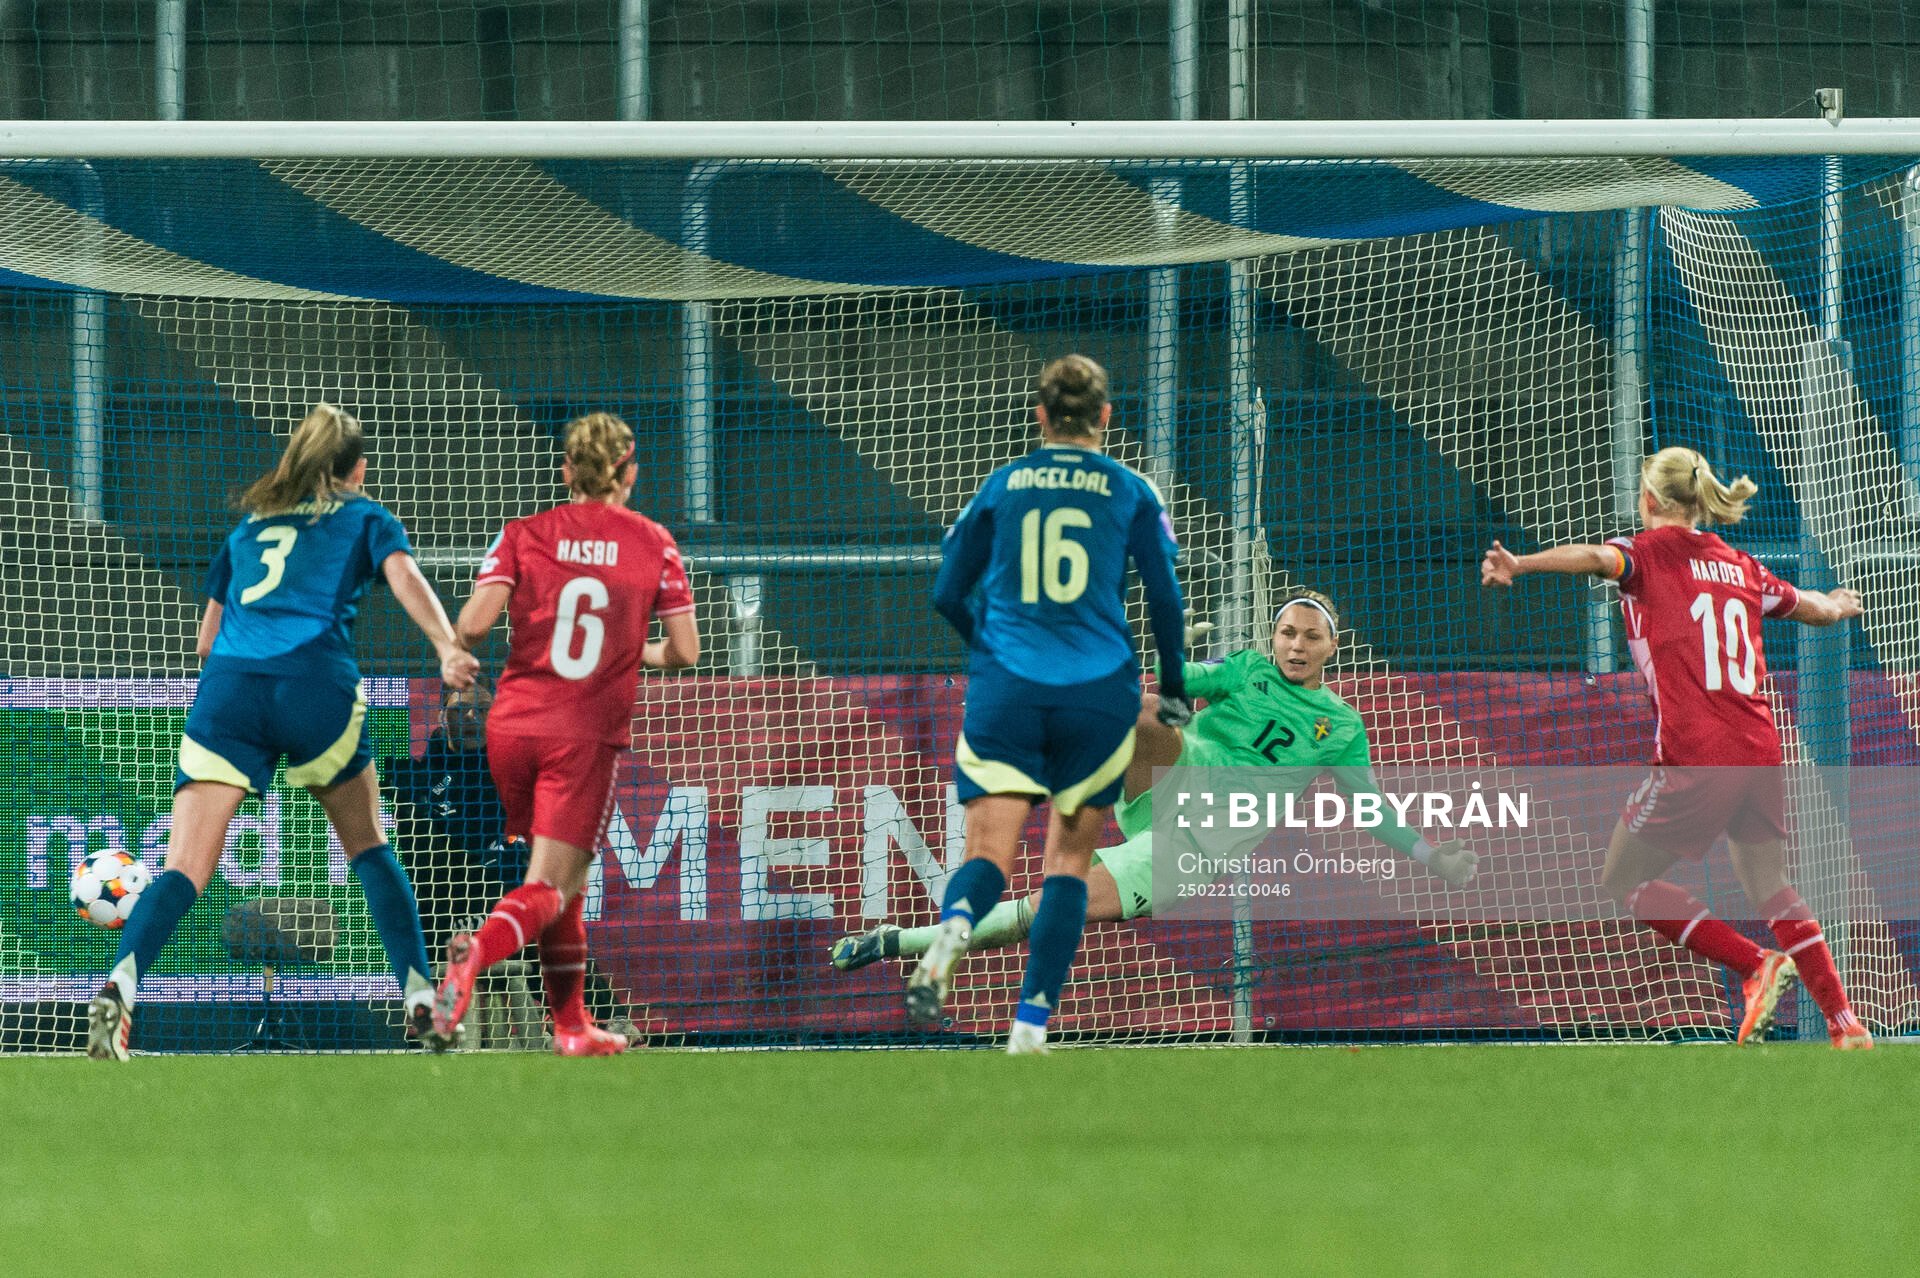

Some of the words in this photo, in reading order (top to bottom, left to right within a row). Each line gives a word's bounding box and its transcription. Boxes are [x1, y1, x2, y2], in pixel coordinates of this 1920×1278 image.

[1006, 467, 1113, 497] ANGELDAL
[240, 525, 298, 605] 3
[557, 539, 619, 567] HASBO
[1020, 507, 1093, 604] 16
[1689, 558, 1746, 589] HARDER
[550, 576, 609, 681] 6
[1690, 592, 1757, 696] 10
[1252, 719, 1295, 764] 12
